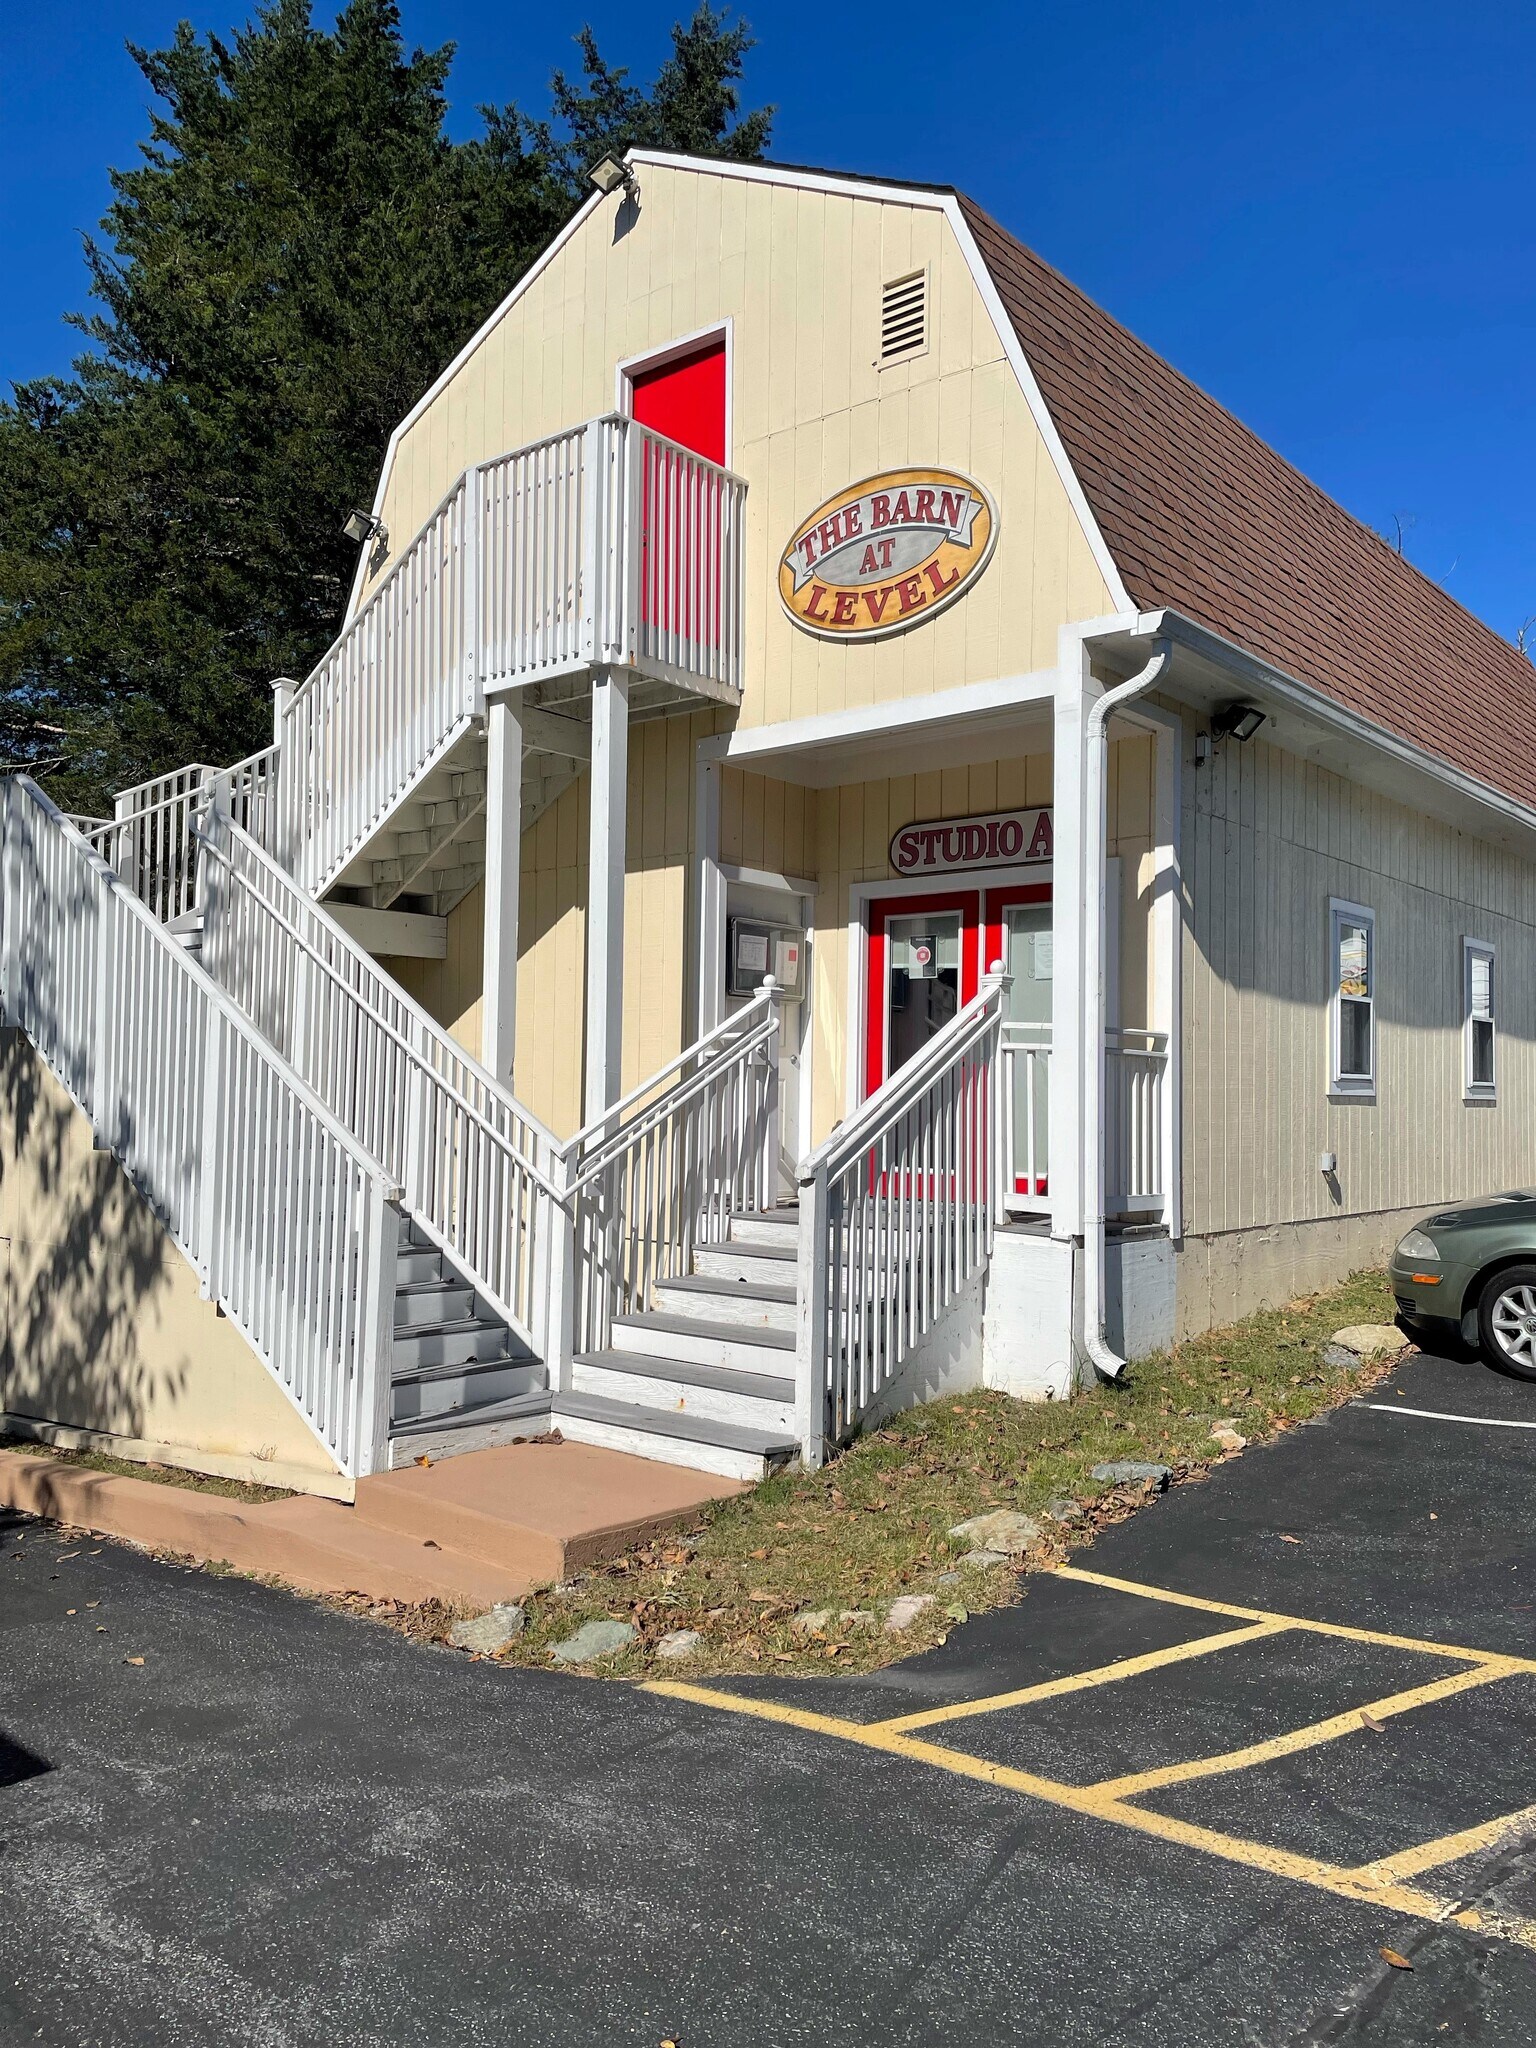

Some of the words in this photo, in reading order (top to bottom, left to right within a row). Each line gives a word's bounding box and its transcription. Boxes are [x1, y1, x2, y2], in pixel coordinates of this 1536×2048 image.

[799, 503, 863, 567] THE
[871, 489, 965, 529] BARN
[859, 538, 895, 575] AT
[803, 559, 960, 625] LEVEL
[898, 820, 1024, 868] STUDIO
[1026, 812, 1054, 858] A
